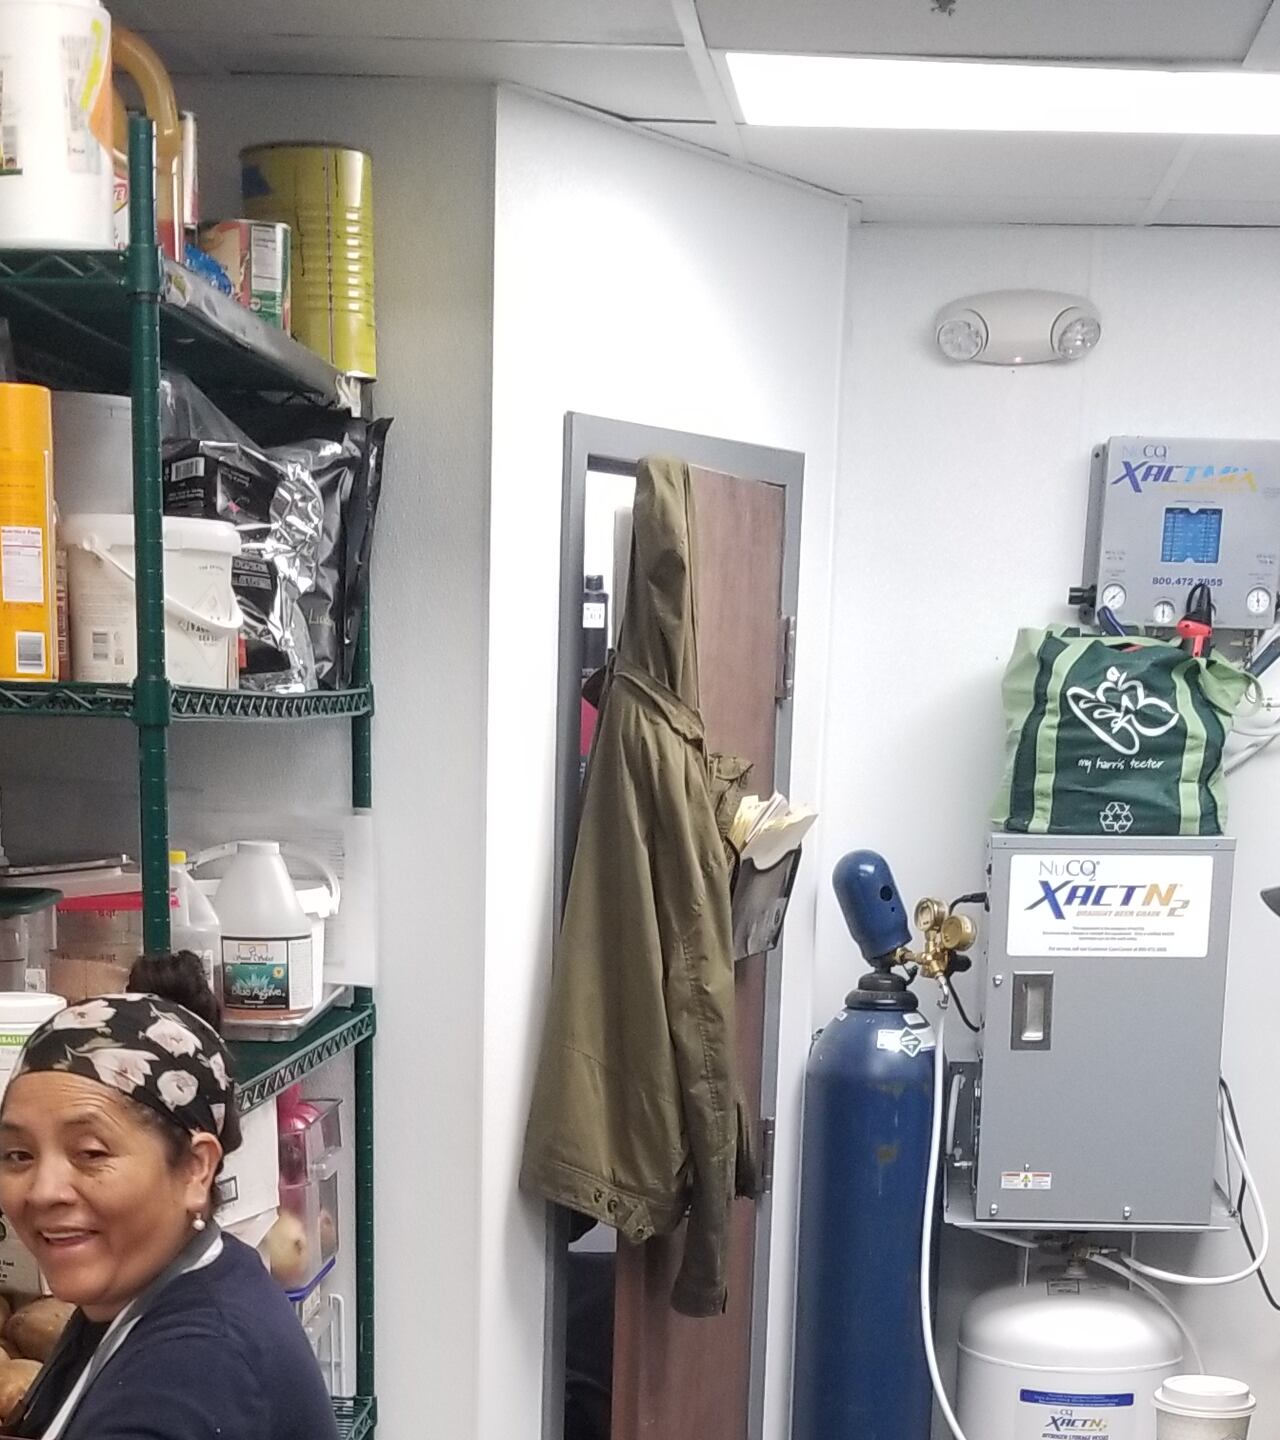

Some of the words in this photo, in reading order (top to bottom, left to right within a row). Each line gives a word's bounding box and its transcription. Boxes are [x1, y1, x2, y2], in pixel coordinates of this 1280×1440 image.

[1077, 758, 1092, 774] my
[1096, 757, 1126, 770] harris
[1130, 757, 1165, 769] teeter
